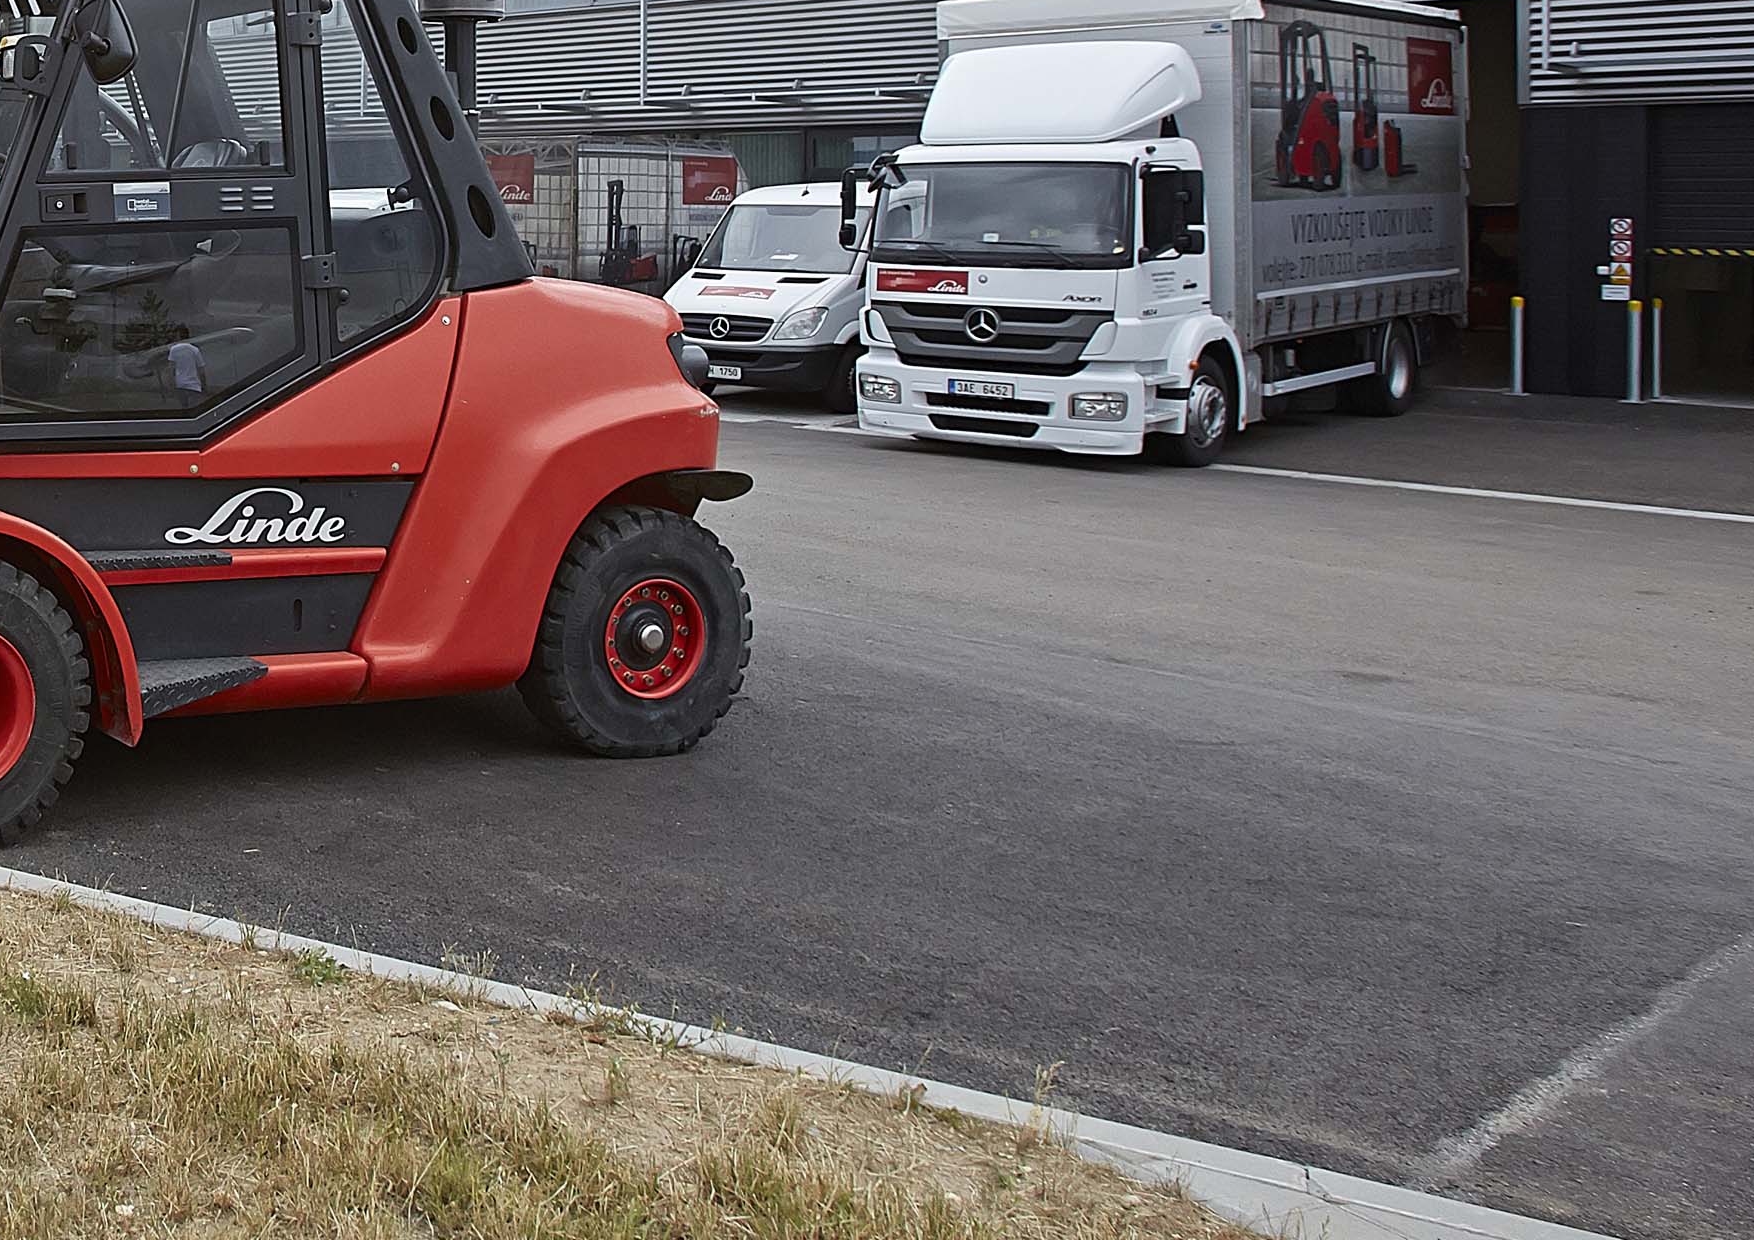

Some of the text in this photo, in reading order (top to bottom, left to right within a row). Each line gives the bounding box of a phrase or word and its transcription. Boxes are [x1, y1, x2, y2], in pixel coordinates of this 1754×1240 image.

[1406, 206, 1434, 235] LINDE
[927, 279, 966, 293] Linde
[957, 382, 1009, 396] 3AE 6452
[164, 487, 345, 544] Linde
